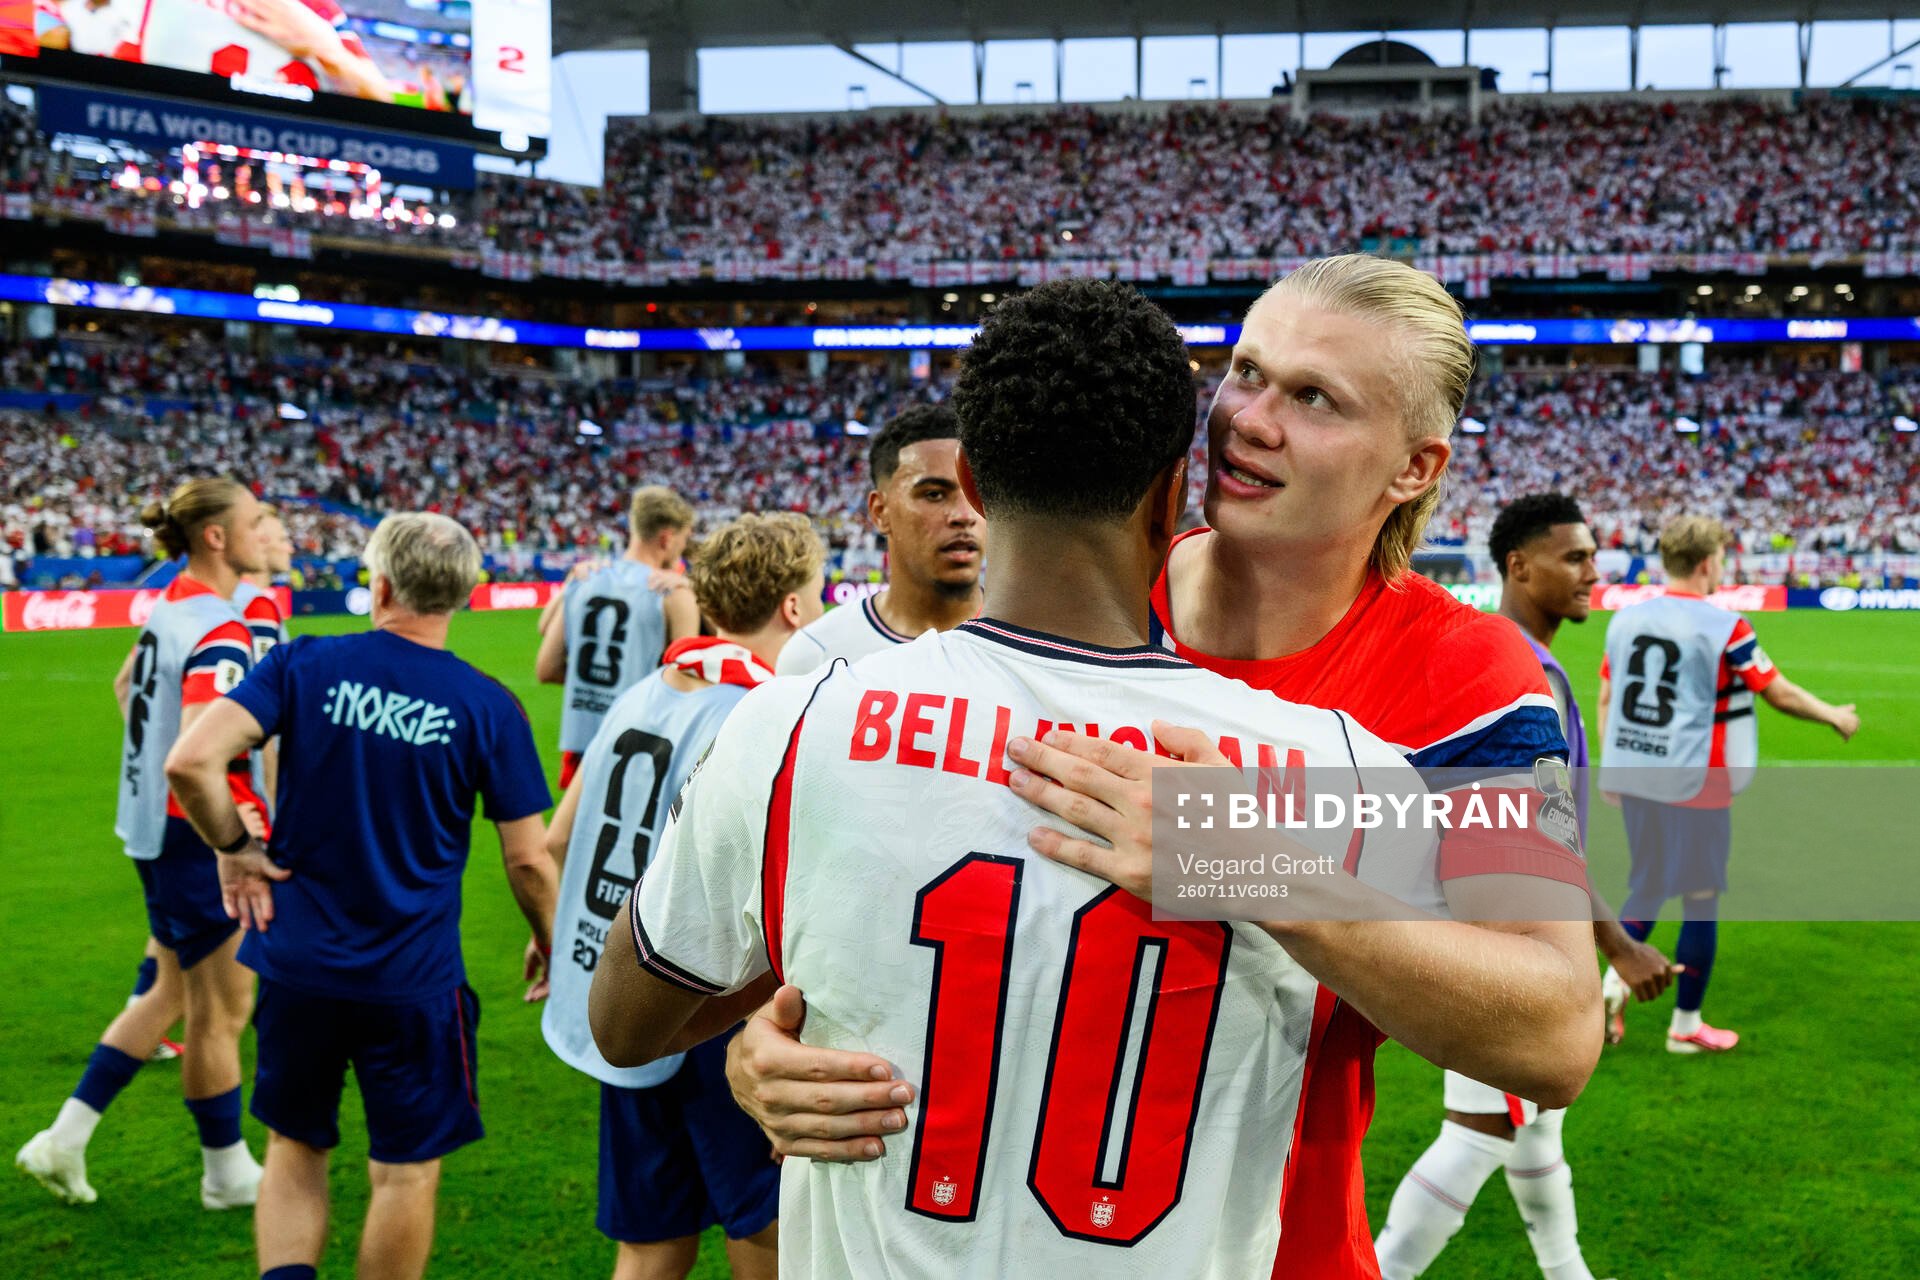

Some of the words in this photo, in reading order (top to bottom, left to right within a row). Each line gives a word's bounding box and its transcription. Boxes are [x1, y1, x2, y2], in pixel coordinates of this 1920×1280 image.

[498, 46, 525, 73] 2
[86, 103, 157, 134] FIFA
[161, 113, 274, 146] WORLD
[277, 131, 338, 158] CUP
[338, 143, 441, 175] 2026
[1616, 738, 1668, 757] 2026
[577, 919, 608, 944] WORL
[905, 851, 1234, 1248] 10
